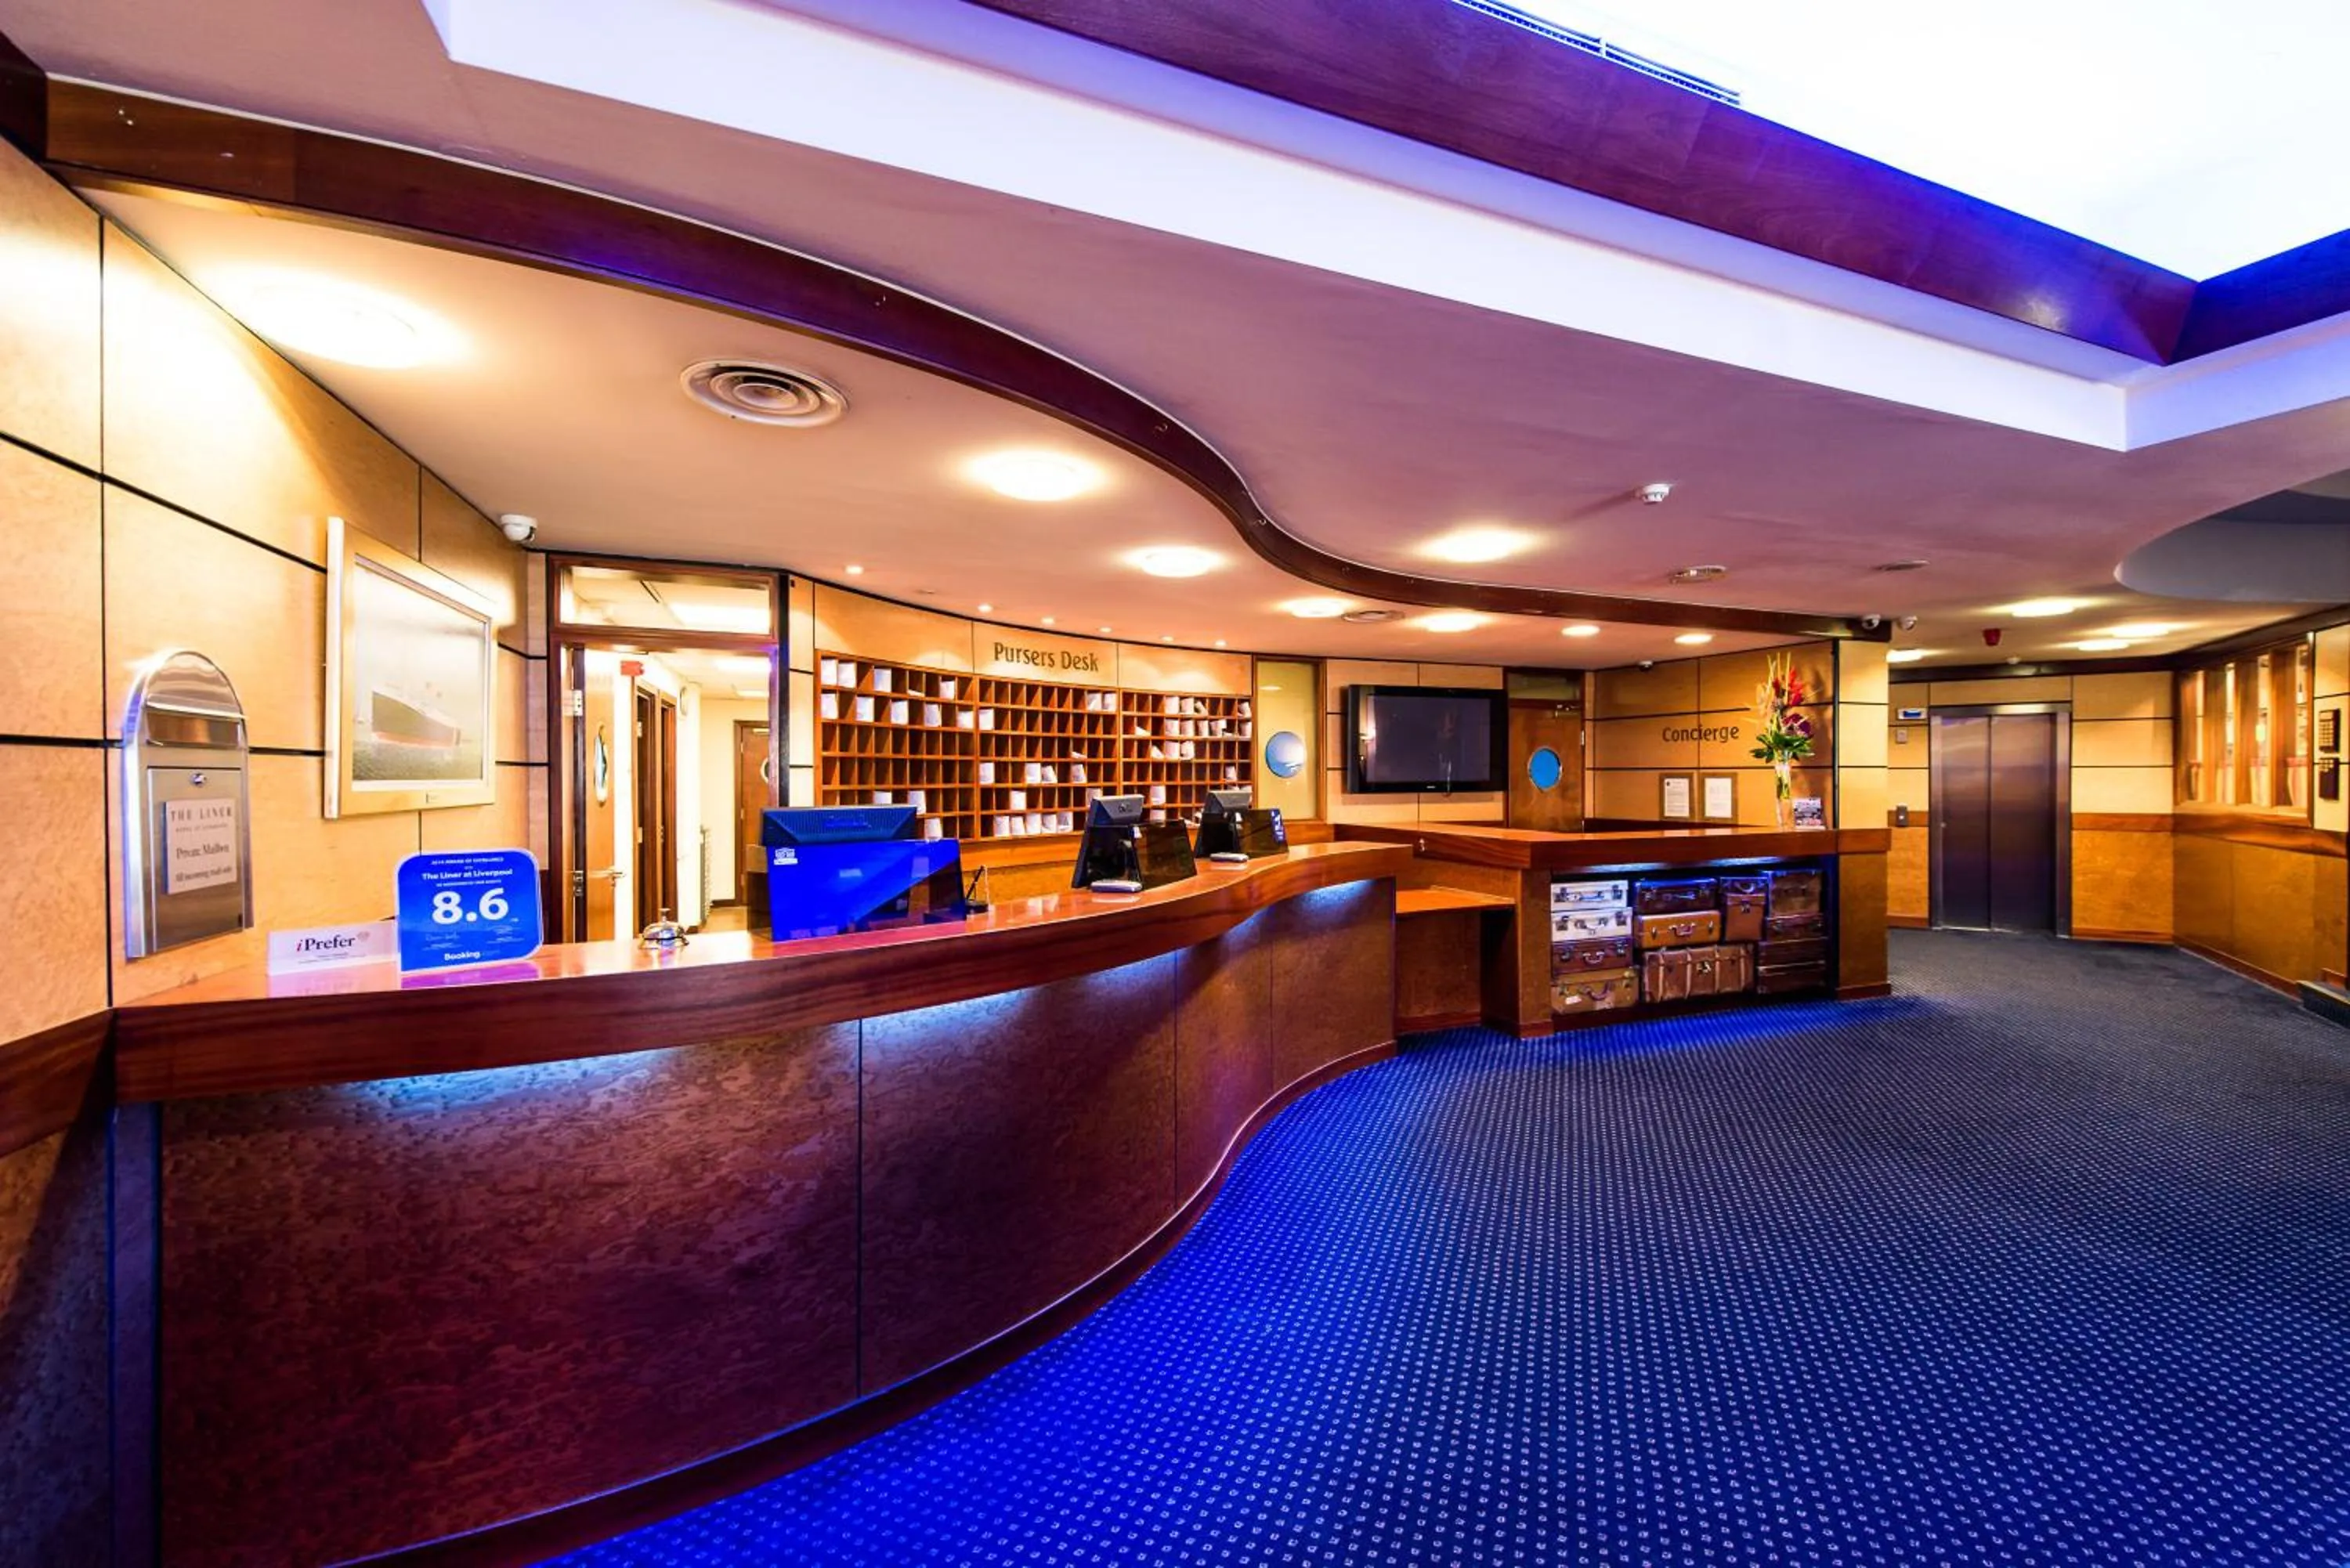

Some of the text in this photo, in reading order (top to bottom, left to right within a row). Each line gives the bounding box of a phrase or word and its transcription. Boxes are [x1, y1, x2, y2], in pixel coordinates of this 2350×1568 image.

[993, 641, 1099, 671] Pursers Desk
[1661, 724, 1740, 743] Concierge
[473, 869, 513, 877] Liverpool
[432, 887, 508, 925] 8.6
[443, 951, 481, 961] Booking
